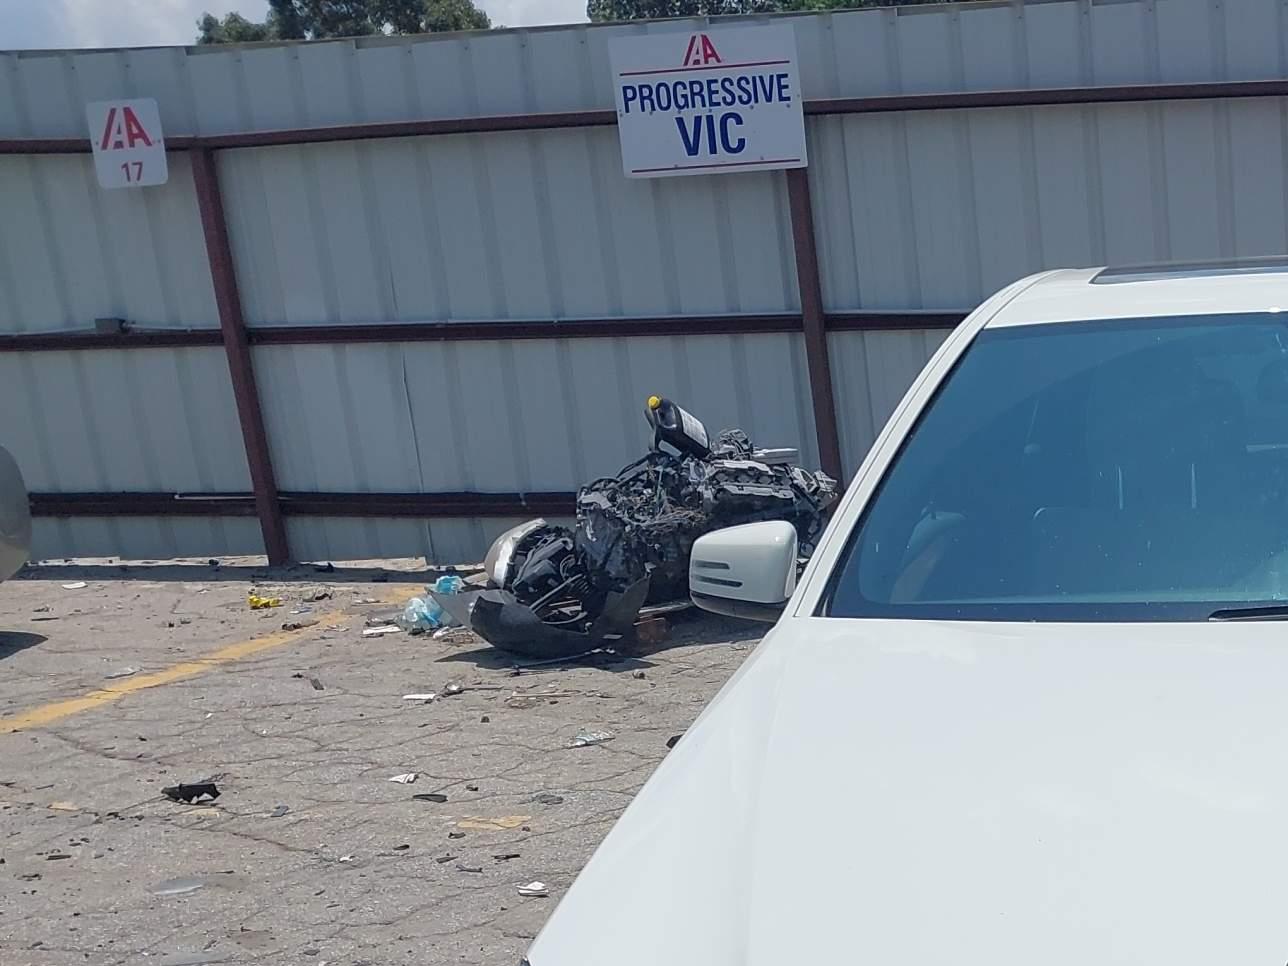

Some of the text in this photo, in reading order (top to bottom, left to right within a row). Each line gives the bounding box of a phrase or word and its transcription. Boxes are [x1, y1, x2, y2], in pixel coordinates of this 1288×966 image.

[622, 73, 791, 114] PROGRESSIVE
[675, 112, 746, 157] VIC
[121, 161, 143, 182] 17
